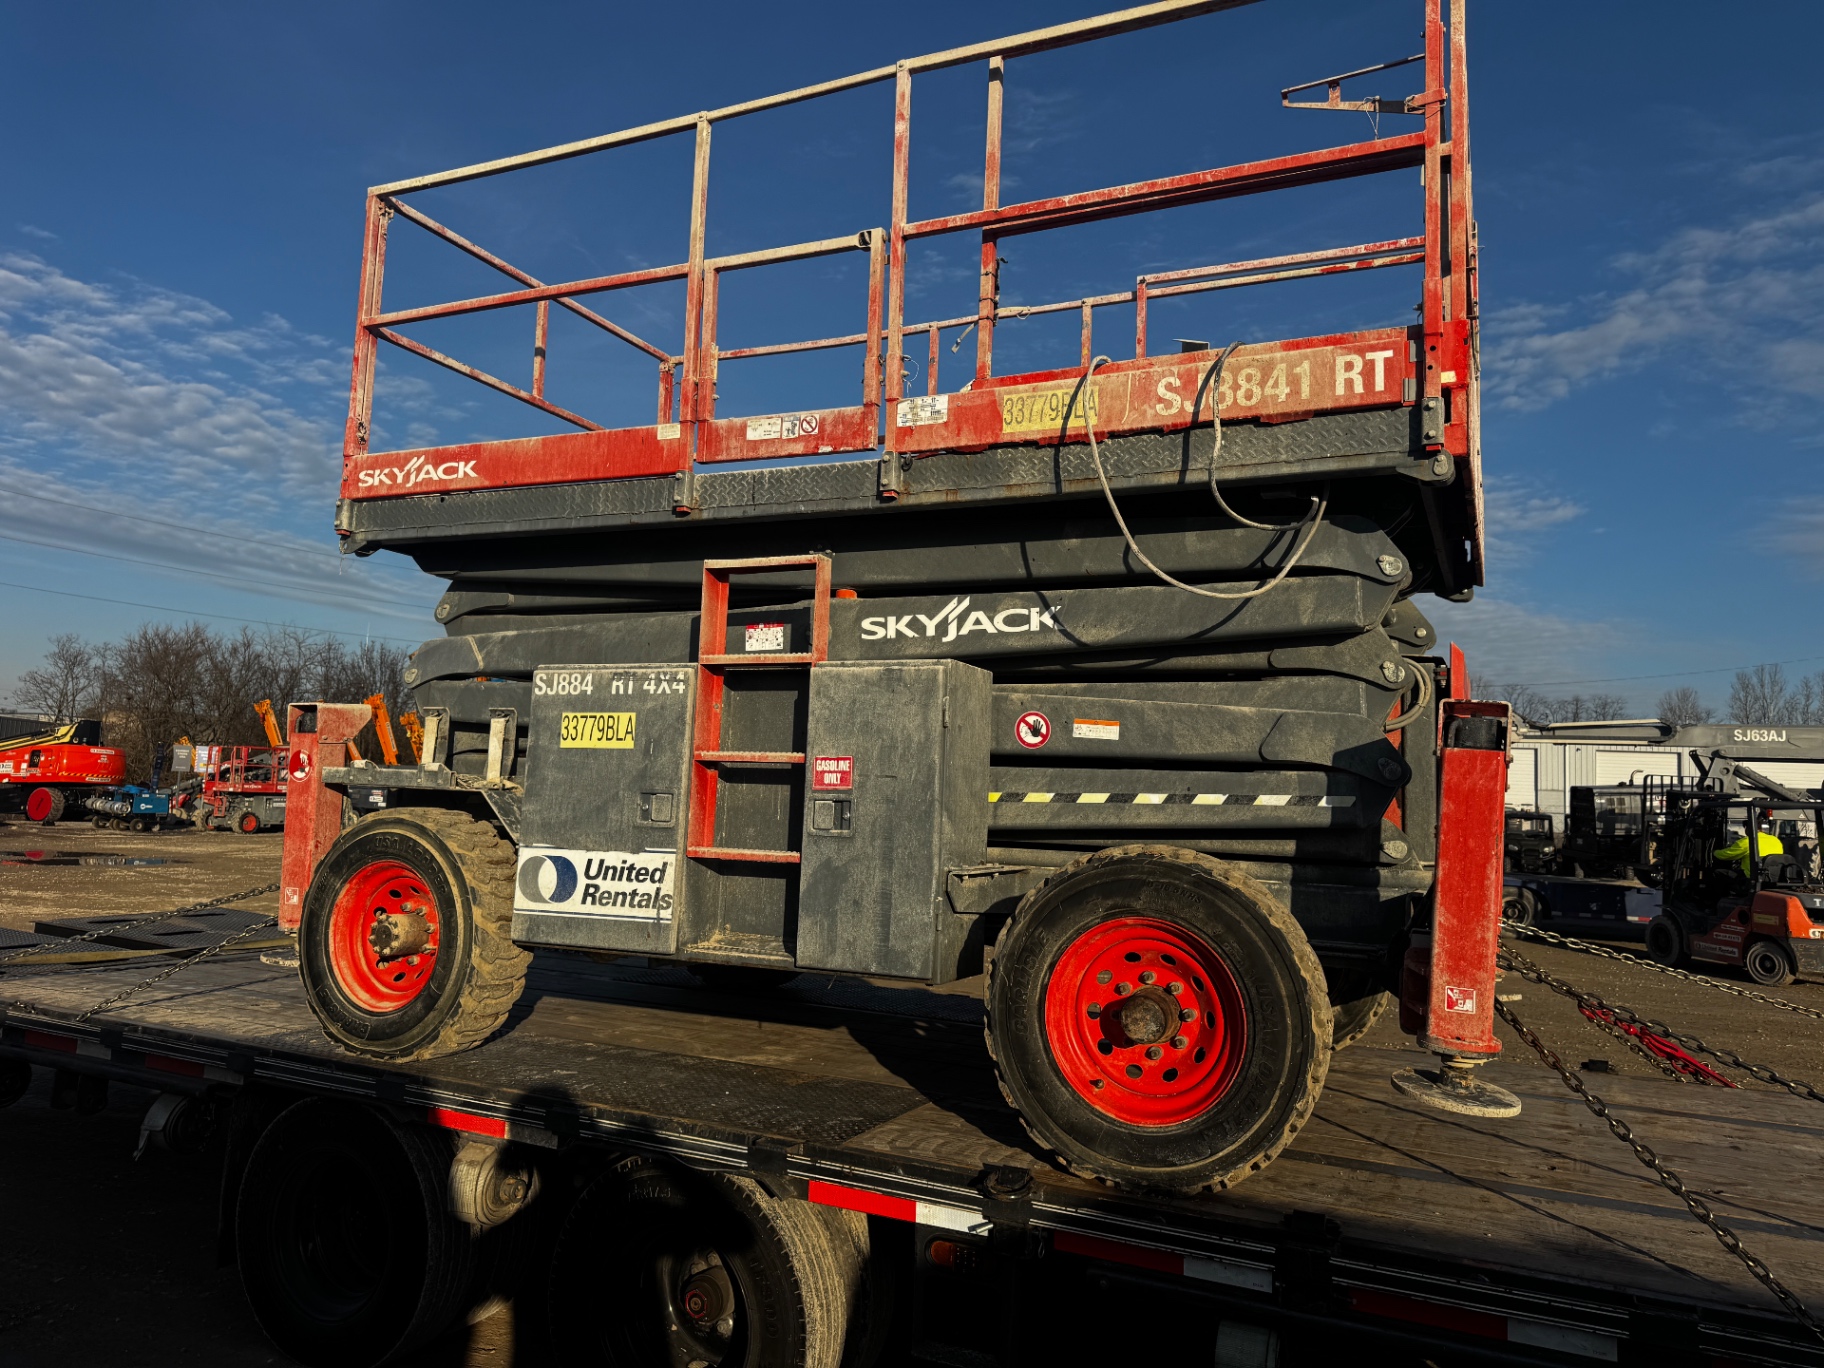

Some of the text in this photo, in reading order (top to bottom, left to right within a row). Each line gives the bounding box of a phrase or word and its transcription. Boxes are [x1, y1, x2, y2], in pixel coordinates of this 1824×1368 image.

[1155, 349, 1394, 416] SJ8841 RT
[1003, 388, 1098, 425] 33779BLA
[358, 454, 479, 488] SKYJACK
[861, 595, 1066, 643] SKYJACK
[561, 714, 635, 742] 33779BLA
[1733, 729, 1787, 742] SJ63AJ
[816, 759, 851, 772] GASOLINE
[823, 772, 842, 785] ONLY
[584, 858, 669, 884] United
[580, 883, 674, 911] Rentals
